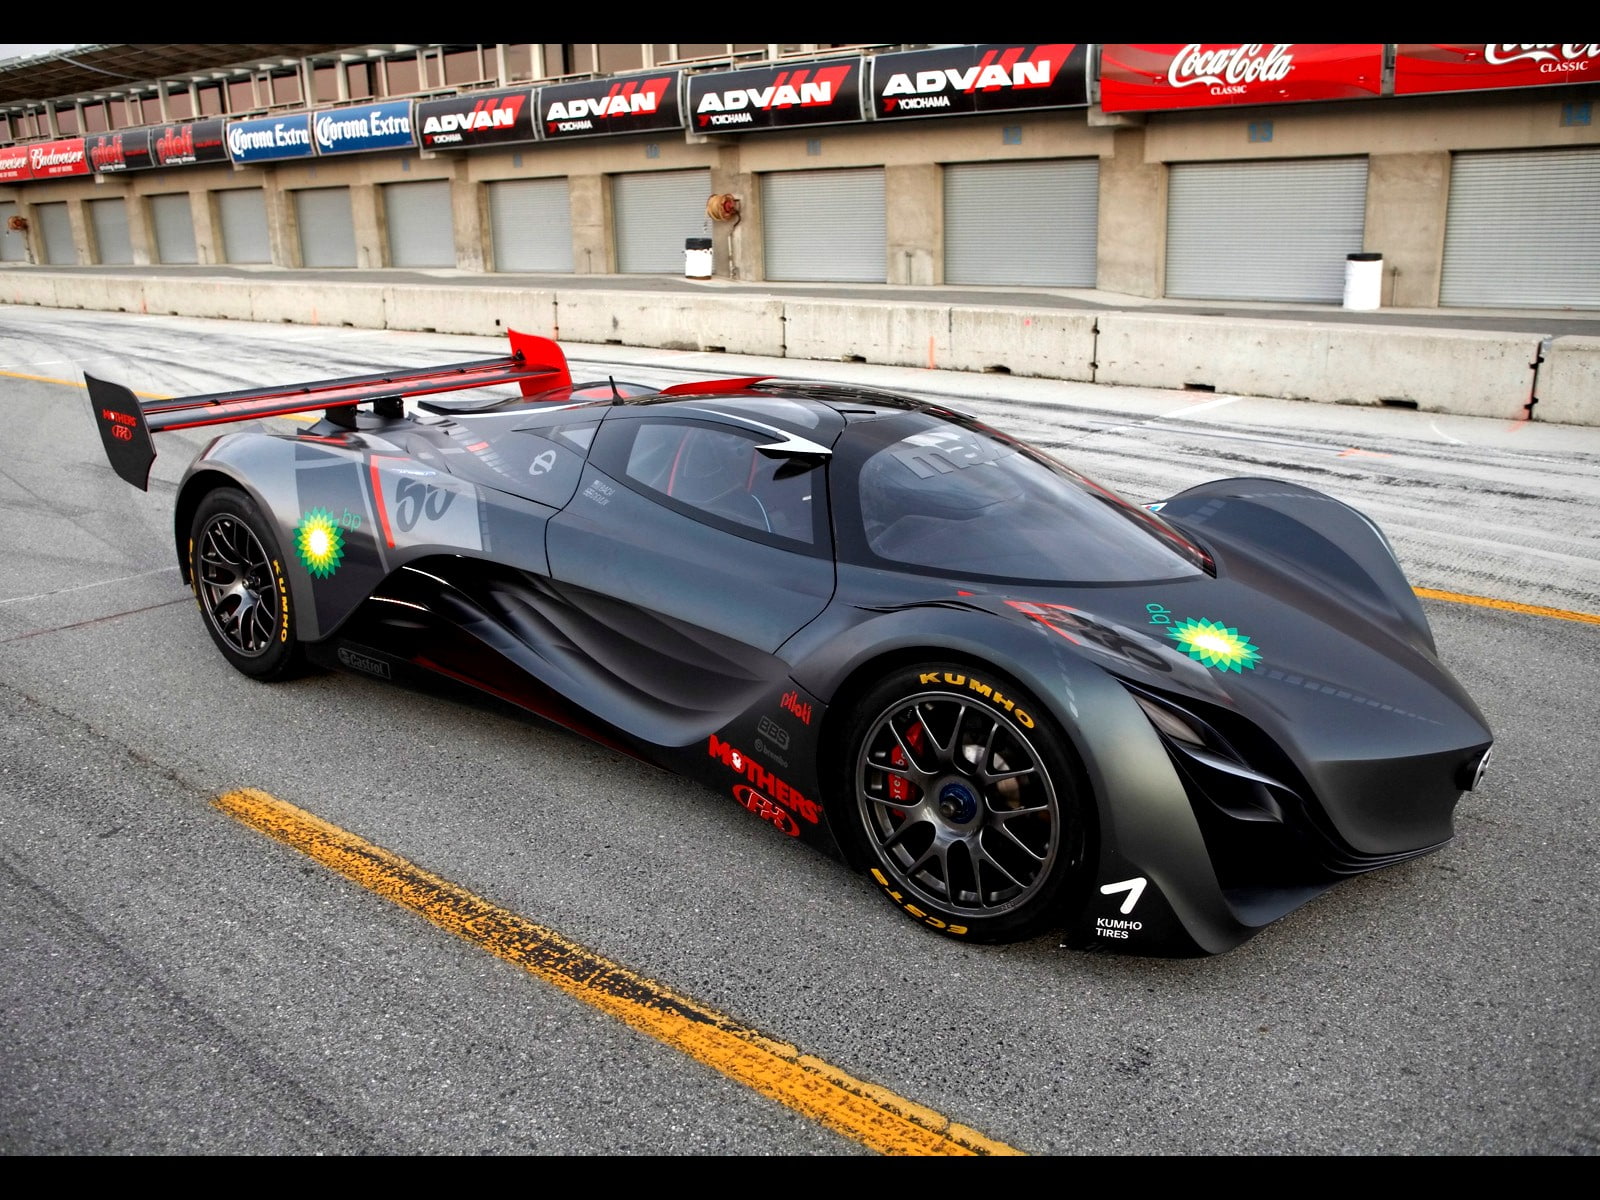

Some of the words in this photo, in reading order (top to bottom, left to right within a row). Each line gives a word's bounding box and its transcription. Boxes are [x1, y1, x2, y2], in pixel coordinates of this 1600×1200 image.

[882, 60, 1051, 97] ADVAN
[1540, 61, 1588, 73] CLASSIC
[697, 81, 832, 113] ADVAN
[898, 95, 950, 110] YOKOHAMA
[1210, 84, 1247, 96] CLASSIC
[546, 92, 656, 121] ADVAN
[710, 112, 752, 125] YOKOHAMA
[316, 116, 368, 148] Corona
[370, 111, 410, 136] Extra
[423, 108, 513, 134] ADVAN
[557, 119, 593, 132] YOKOHAMA
[230, 127, 274, 158] Corona
[275, 123, 310, 147] Extra
[0, 153, 27, 170] weiser
[31, 148, 83, 170] Budweiser
[341, 508, 362, 533] bp
[272, 559, 289, 642] KUMHO
[1146, 602, 1171, 625] bp
[350, 653, 385, 675] Castrol
[780, 690, 812, 725] piloti
[919, 671, 1035, 729] KUMHO
[757, 715, 790, 750] BBS
[708, 733, 820, 825] MOTHERS
[1095, 927, 1129, 940] TIRES
[1096, 917, 1143, 931] KUMHO
